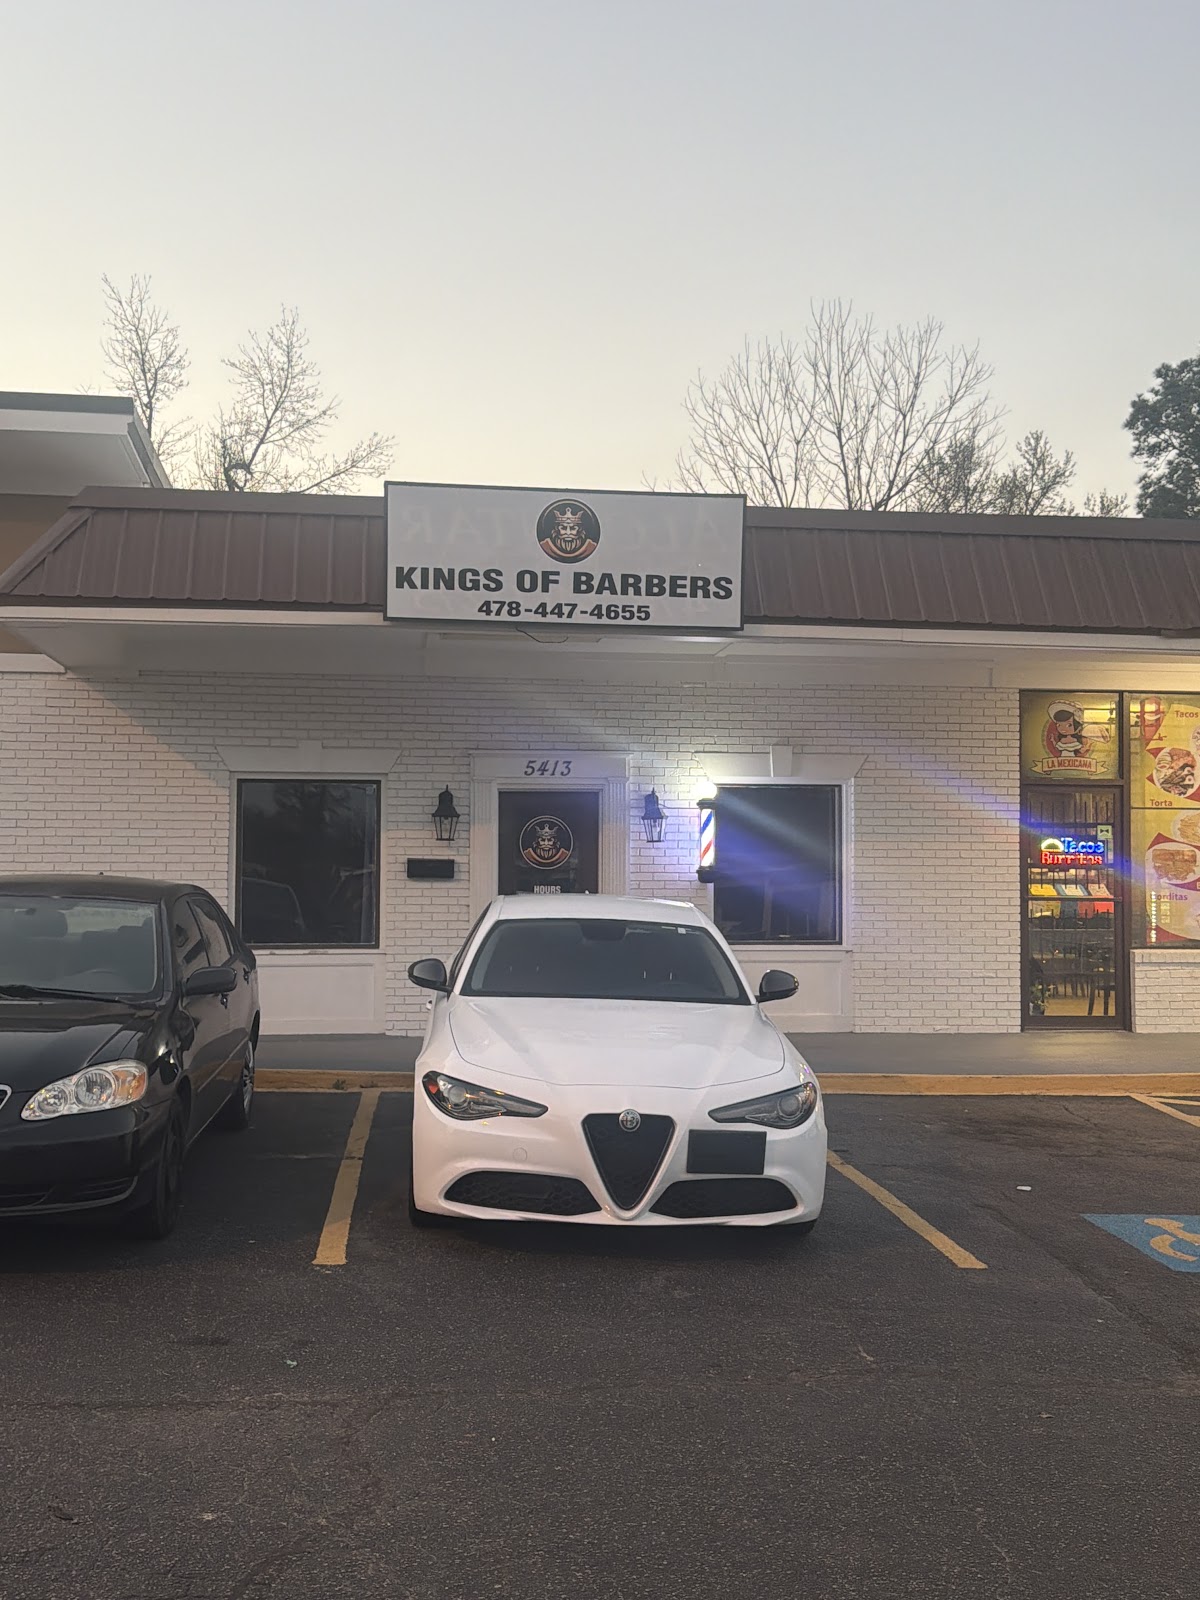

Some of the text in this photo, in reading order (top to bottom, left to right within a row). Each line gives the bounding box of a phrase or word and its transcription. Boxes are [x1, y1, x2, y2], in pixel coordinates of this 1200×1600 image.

[395, 566, 733, 600] KINGS OF BARBERS
[477, 600, 651, 621] 478-447-4655
[1174, 710, 1199, 718] Tacos
[524, 760, 572, 776] 5413
[1046, 759, 1092, 769] LA MEXICANA
[1149, 799, 1172, 807] Torta
[1061, 837, 1104, 853] Tacos
[1041, 852, 1103, 865] Burritos
[534, 885, 561, 894] HOURS
